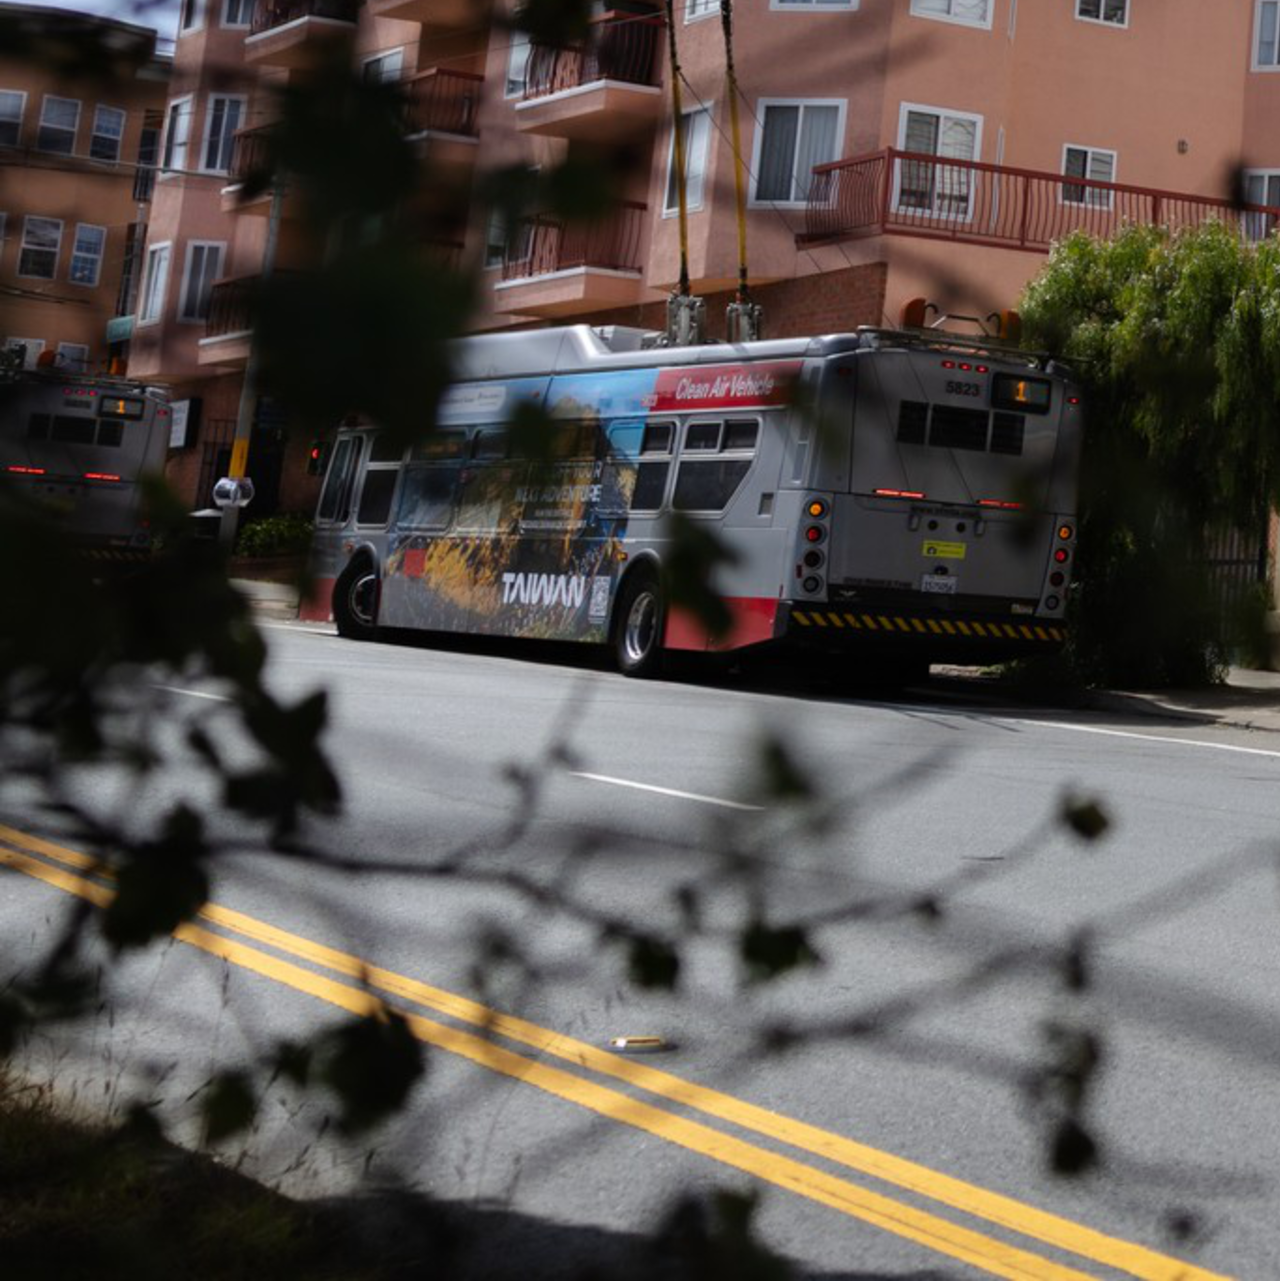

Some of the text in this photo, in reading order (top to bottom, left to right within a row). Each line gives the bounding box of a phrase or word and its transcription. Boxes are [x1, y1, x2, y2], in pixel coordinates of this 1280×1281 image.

[675, 372, 775, 400] Clean Air Vehicle
[945, 380, 980, 397] 5823
[1015, 381, 1026, 402] 1
[116, 400, 125, 414] 1
[502, 571, 586, 609] TAIWAN
